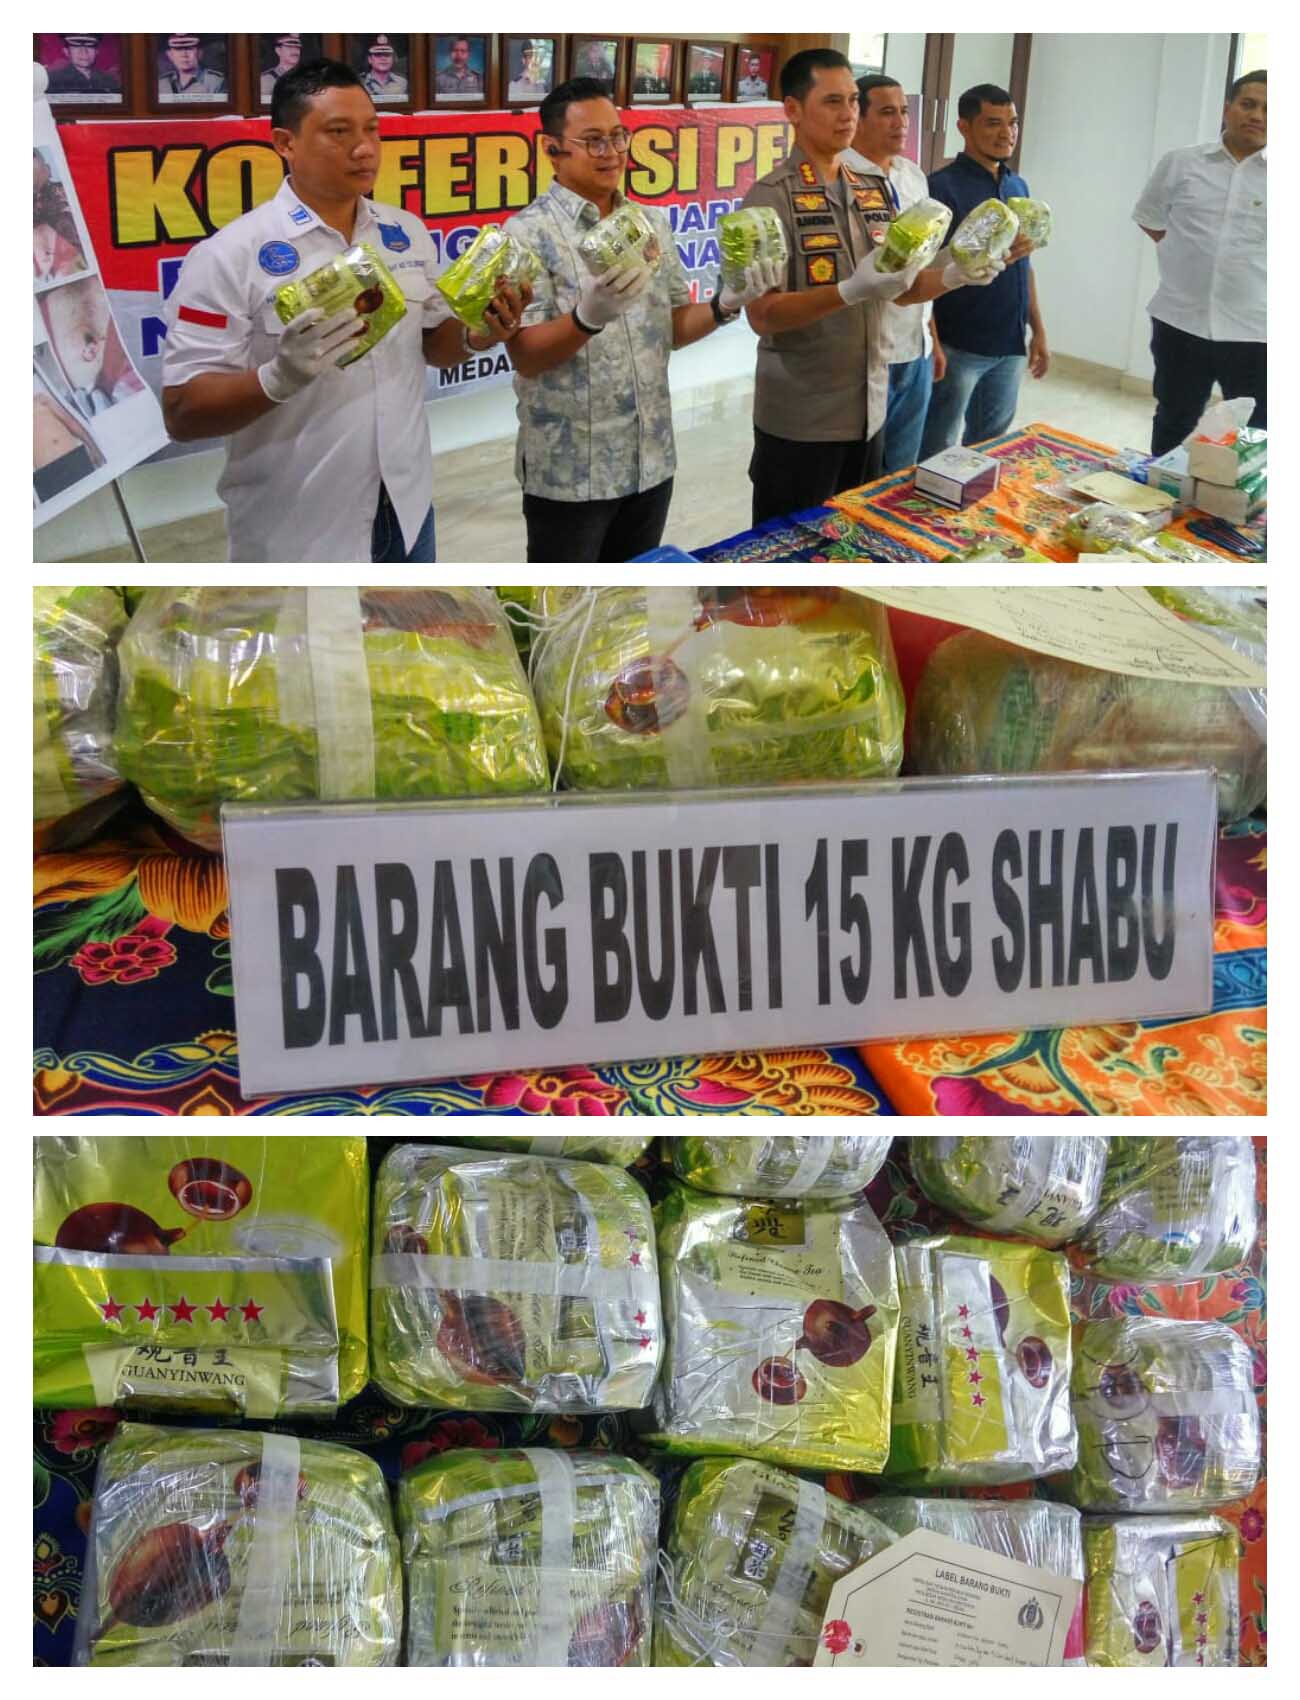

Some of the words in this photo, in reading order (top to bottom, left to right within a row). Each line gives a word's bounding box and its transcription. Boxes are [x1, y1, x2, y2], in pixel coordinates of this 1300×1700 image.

[439, 353, 512, 387] MEDA
[275, 852, 568, 1051] BARANG
[589, 843, 782, 1025] BUKTI
[805, 838, 872, 1006] 15
[891, 831, 973, 999] KG
[992, 822, 1178, 992] SHABU
[902, 1316, 917, 1399] GUANYINWANG
[121, 1365, 246, 1387] GUANYINWANG
[935, 1568, 957, 1584] LABEL
[960, 1576, 989, 1593] BARANG
[990, 1585, 1011, 1599] BUKTI
